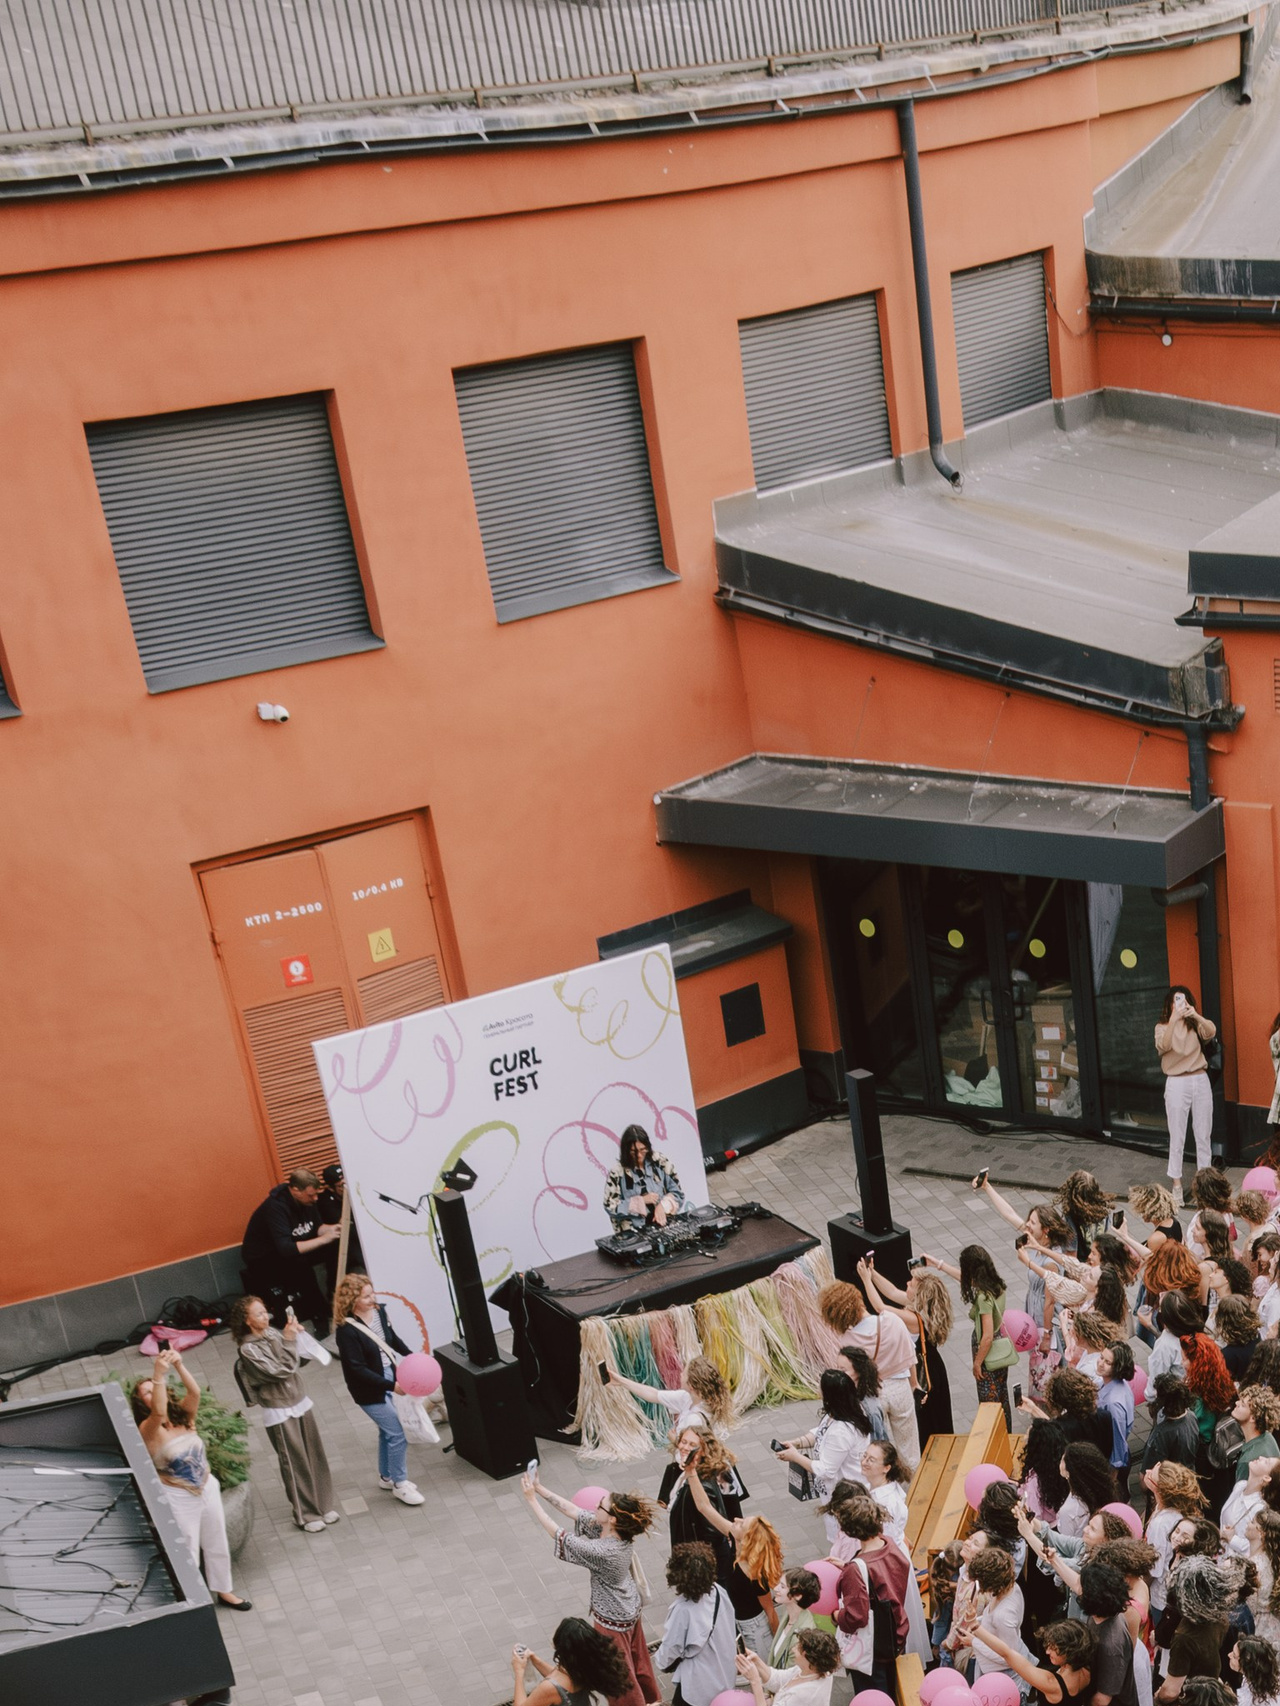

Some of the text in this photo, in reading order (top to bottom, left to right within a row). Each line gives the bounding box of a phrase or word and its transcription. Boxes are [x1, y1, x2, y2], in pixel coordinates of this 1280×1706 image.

[245, 902, 323, 928] КТП 2-2500
[489, 1046, 542, 1076] CURL
[494, 1070, 538, 1101] FEST
